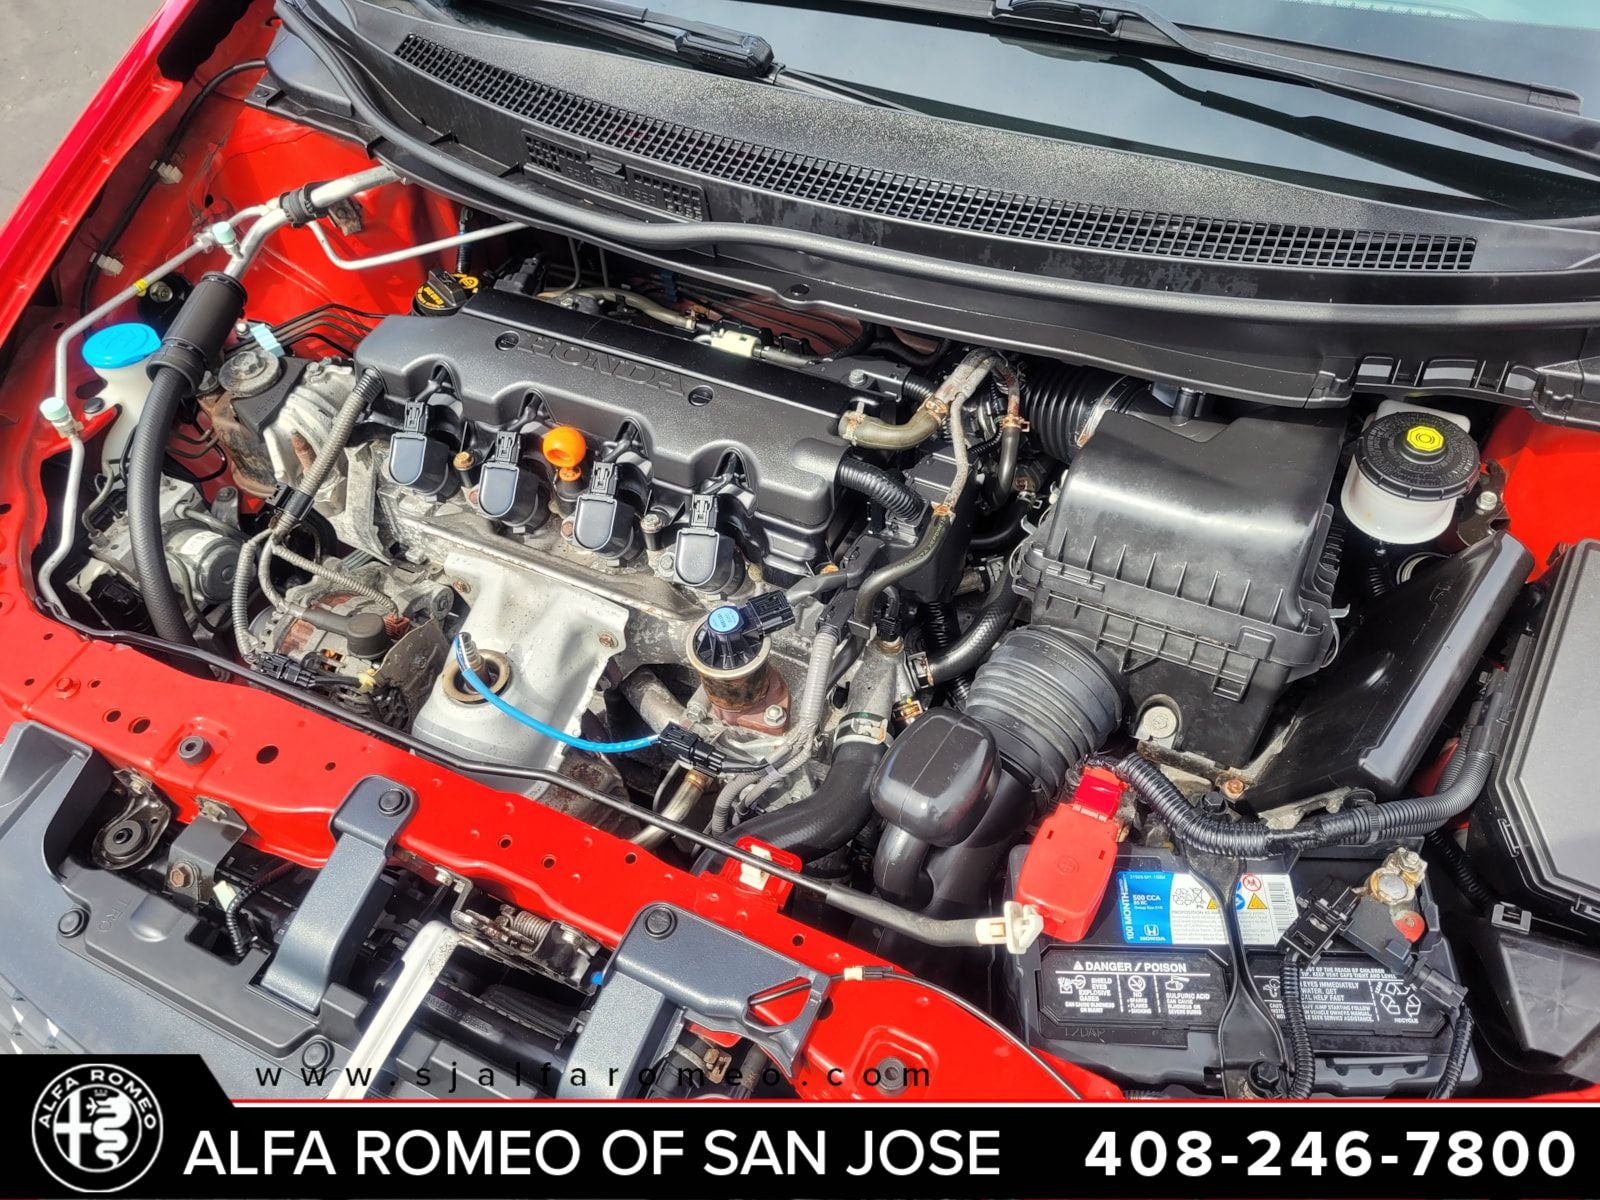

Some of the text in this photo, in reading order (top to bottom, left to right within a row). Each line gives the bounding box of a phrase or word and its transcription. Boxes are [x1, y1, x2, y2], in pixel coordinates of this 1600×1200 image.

[517, 334, 686, 397] HONDA
[1121, 892, 1133, 925] MONTH
[1126, 926, 1134, 940] 100
[1085, 961, 1132, 972] DANGER
[1144, 962, 1187, 973] POISON
[1302, 981, 1319, 989] EYES
[1319, 982, 1360, 990] IMMEDIATELY
[1165, 992, 1195, 1000] SULFURIC
[1312, 994, 1329, 1002] HELP
